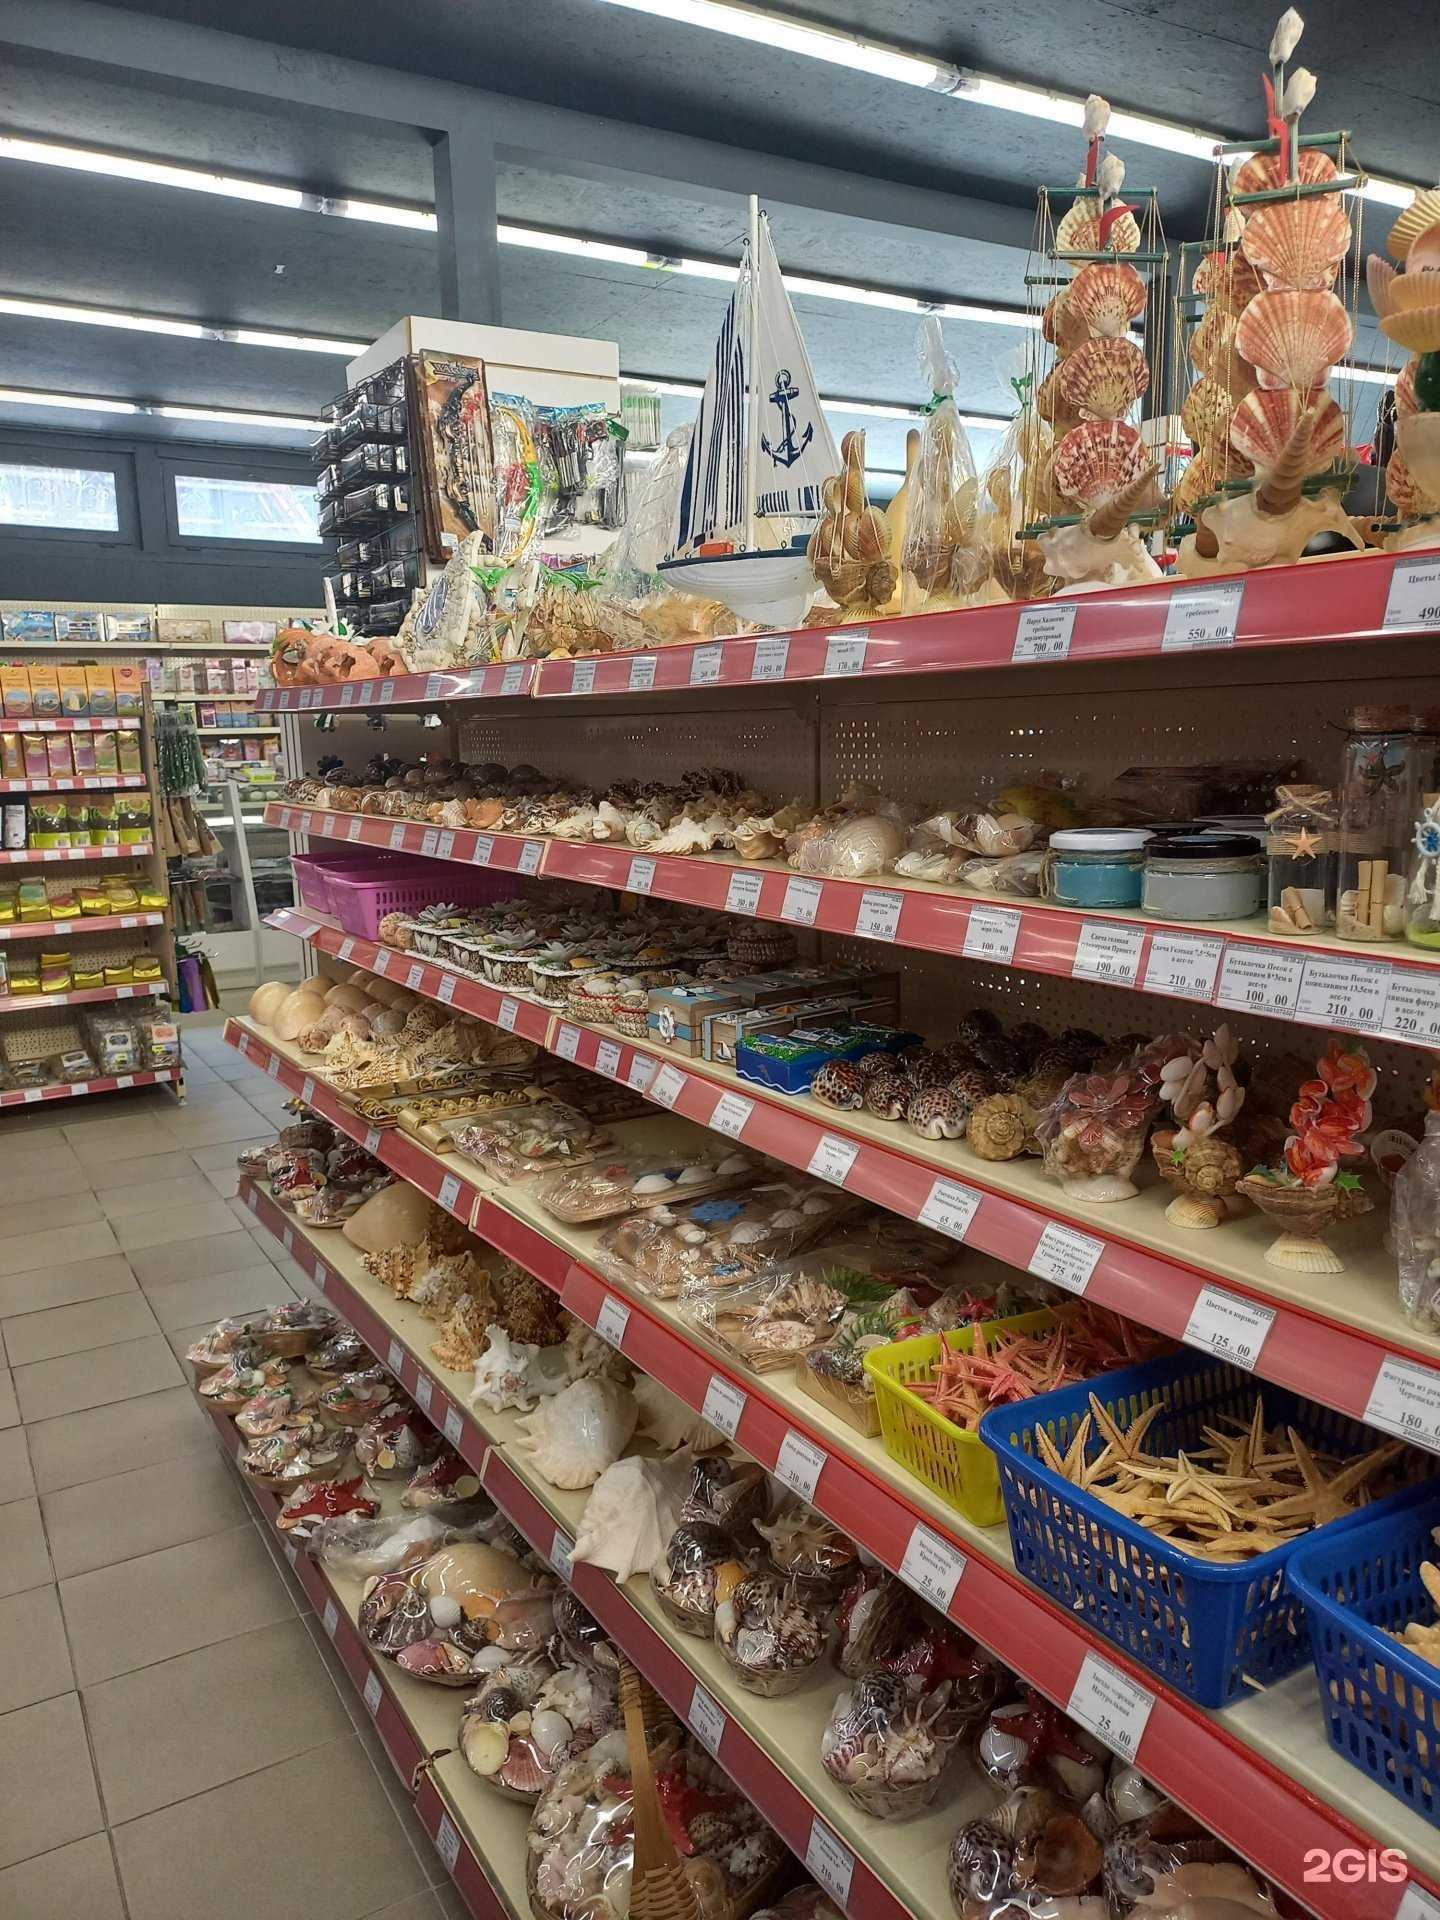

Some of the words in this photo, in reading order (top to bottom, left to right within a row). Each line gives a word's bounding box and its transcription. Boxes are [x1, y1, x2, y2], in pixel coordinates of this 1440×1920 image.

[1187, 628, 1206, 640] 550
[1215, 625, 1228, 638] 00
[1033, 642, 1047, 653] 700
[1053, 641, 1064, 651] 00
[1090, 932, 1107, 942] Свеча
[1152, 943, 1169, 952] Свеча
[1095, 961, 1111, 973] 190
[1119, 964, 1131, 976] 00
[1229, 955, 1266, 969] Бутылочка
[1266, 962, 1287, 973] Песок
[1168, 973, 1186, 986] 210
[1194, 977, 1207, 989] 00
[1309, 968, 1349, 981] Бутылочка
[1350, 973, 1373, 985] Песок
[1391, 981, 1436, 996] Бутылочка
[1246, 989, 1264, 1003] 100
[1274, 993, 1288, 1007] 00
[1326, 1001, 1349, 1016] 210
[1359, 1007, 1374, 1020] 00
[1394, 1016, 1417, 1030] 220
[1429, 1022, 1440, 1034] 0
[1050, 1263, 1065, 1276] 275
[1072, 1272, 1082, 1283] 00
[1210, 1332, 1230, 1348] 125
[1237, 1344, 1250, 1357] 00
[1400, 1411, 1423, 1429] 180
[921, 1574, 933, 1589] 25
[936, 1586, 947, 1600] 00
[1098, 1715, 1111, 1731] 25
[1118, 1730, 1131, 1746] 00
